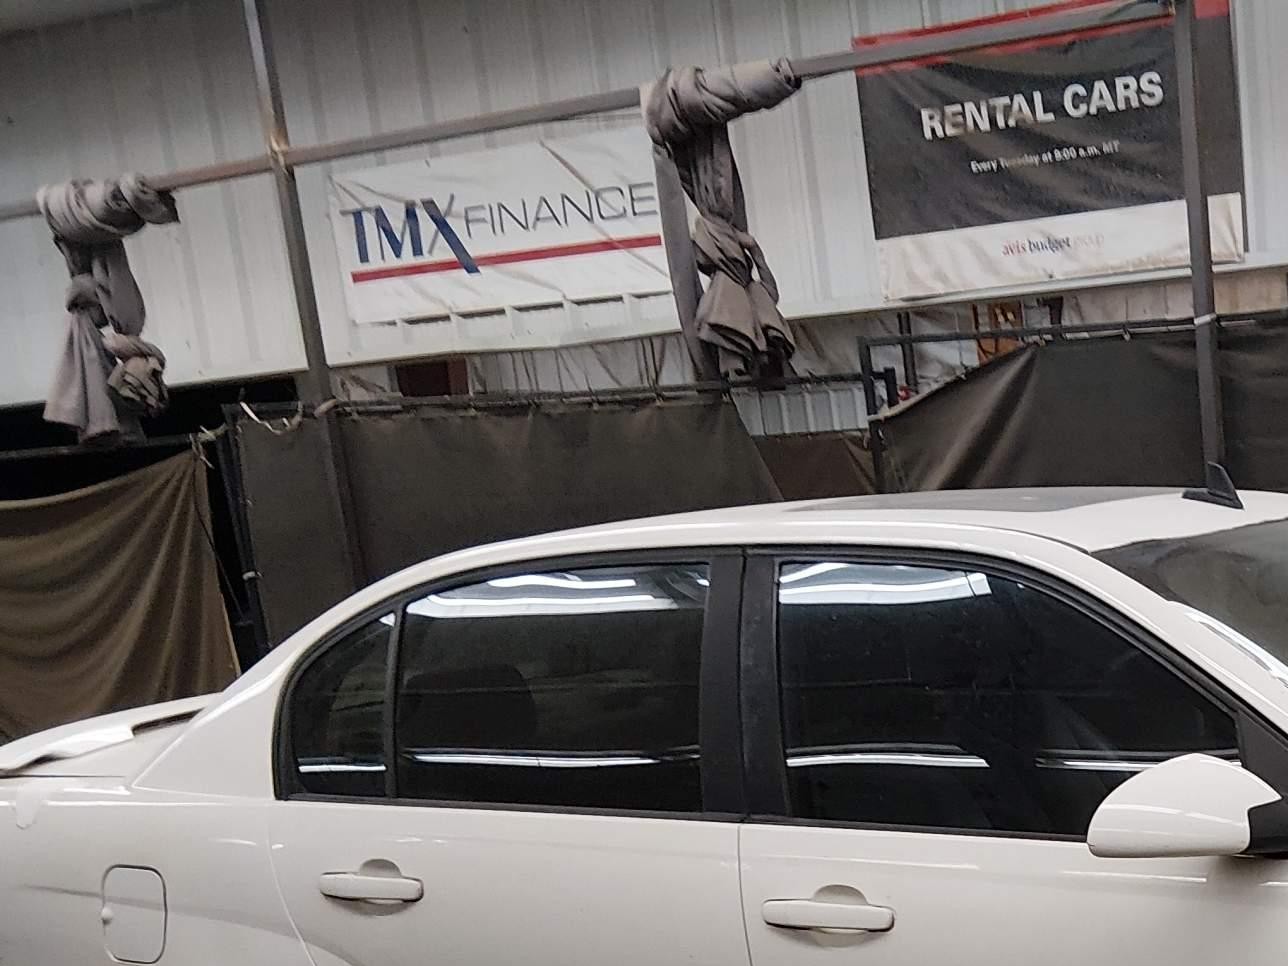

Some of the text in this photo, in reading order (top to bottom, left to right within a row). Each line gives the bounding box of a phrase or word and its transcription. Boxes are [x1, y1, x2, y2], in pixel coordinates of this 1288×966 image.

[920, 71, 1164, 141] RENTAL CARS
[1041, 151, 1053, 164] at
[339, 182, 659, 275] TMX FINANCE
